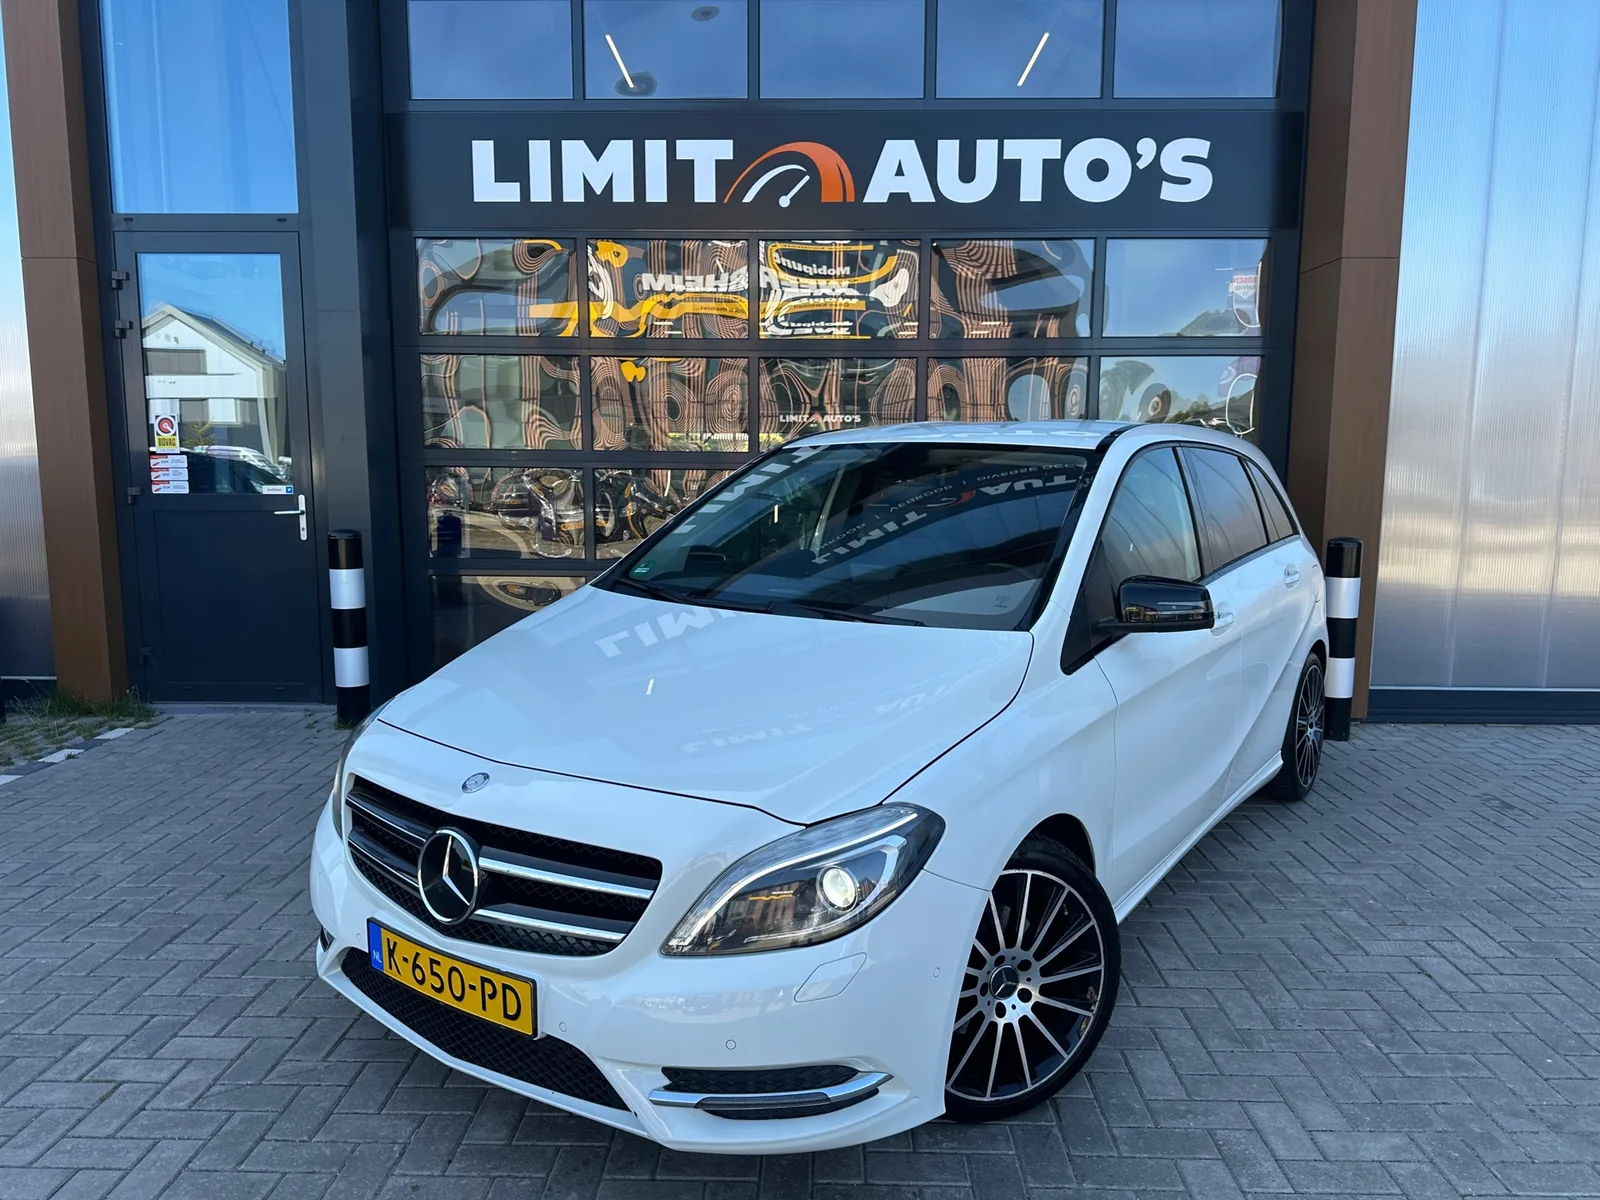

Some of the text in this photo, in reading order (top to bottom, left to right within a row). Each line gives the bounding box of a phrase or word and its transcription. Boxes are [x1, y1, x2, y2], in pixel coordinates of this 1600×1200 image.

[471, 137, 1214, 204] LIMIT AUTO'S
[780, 414, 862, 423] LIMIT AUTO'S
[157, 437, 177, 448] BOVAG
[373, 950, 382, 964] NL
[386, 937, 522, 1021] K-650-PD
